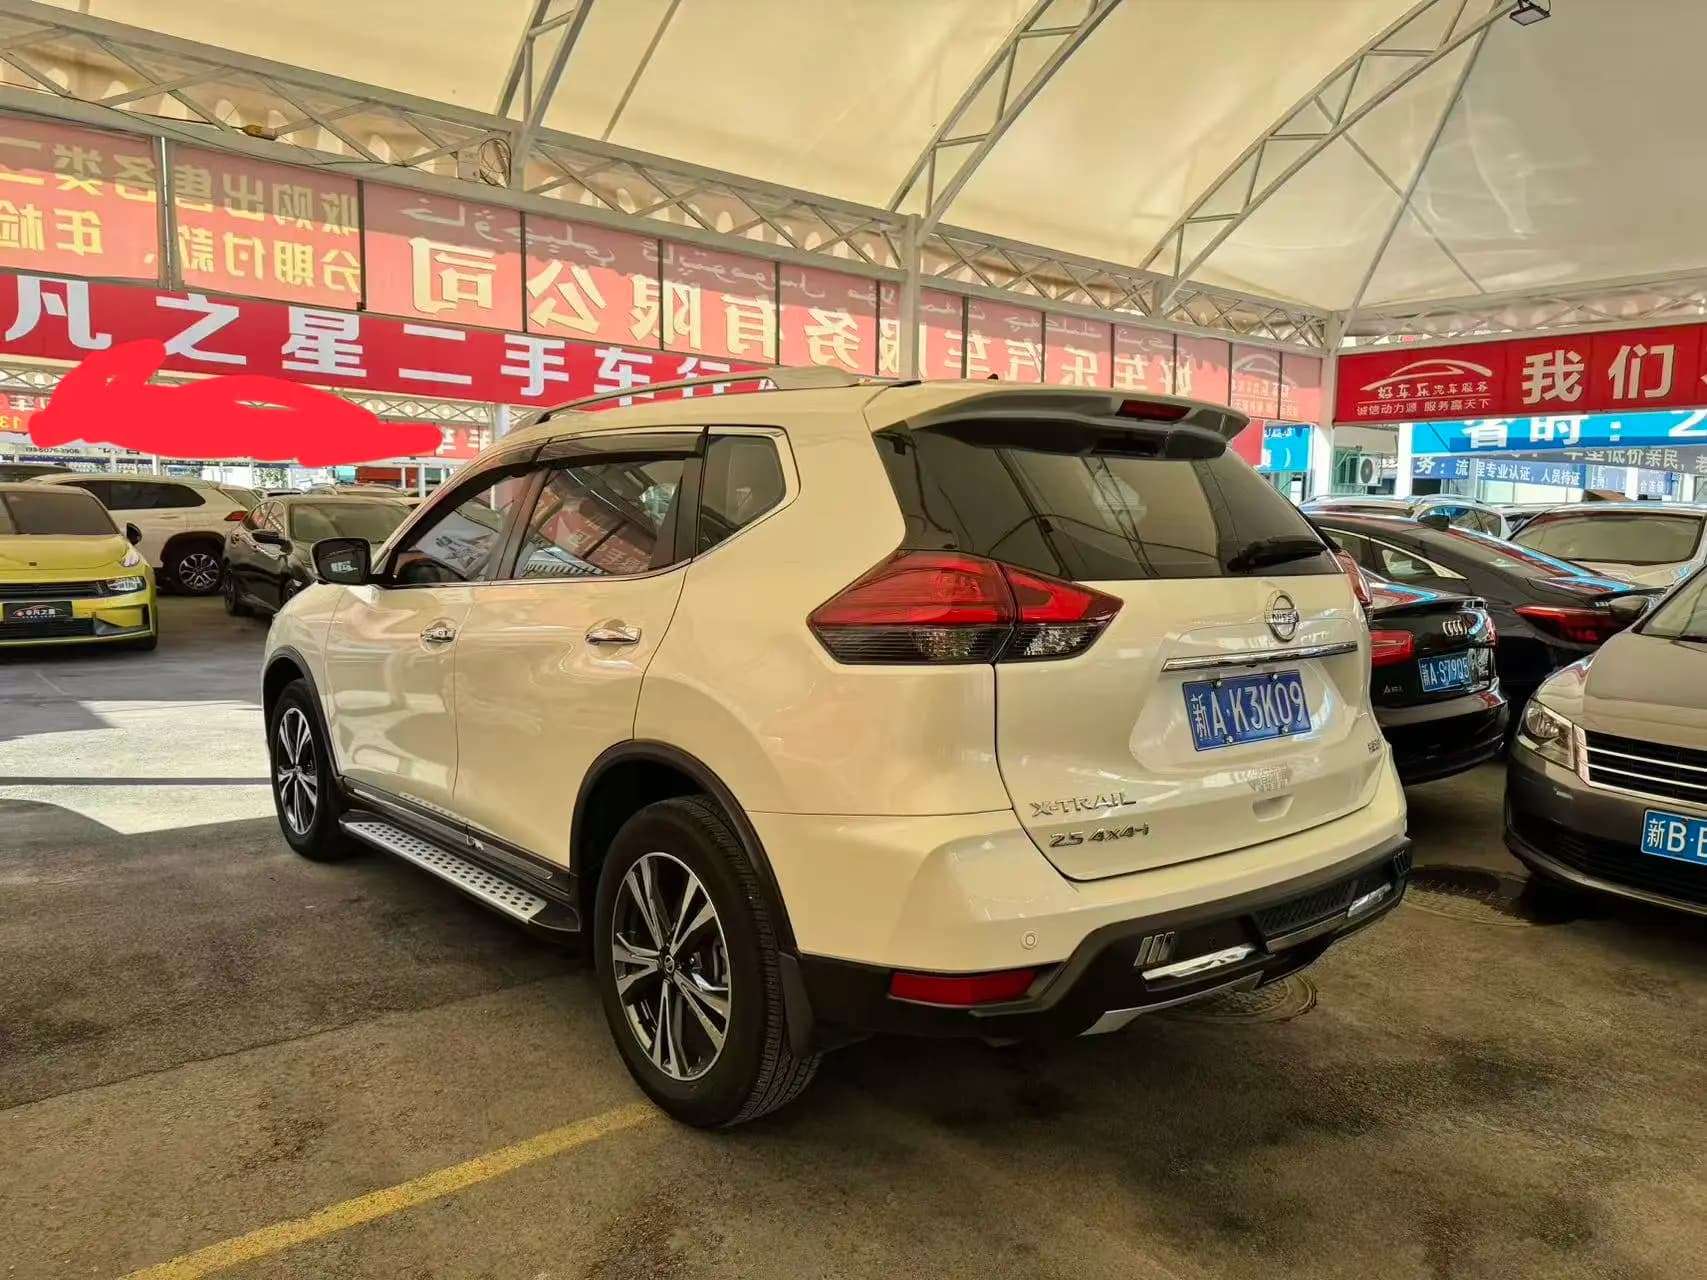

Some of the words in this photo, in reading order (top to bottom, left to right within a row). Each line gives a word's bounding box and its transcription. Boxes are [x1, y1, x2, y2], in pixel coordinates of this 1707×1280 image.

[1522, 343, 1707, 404] 我们
[1356, 402, 1418, 416] 诚信动力源
[1029, 791, 1137, 817] X-TRAIL
